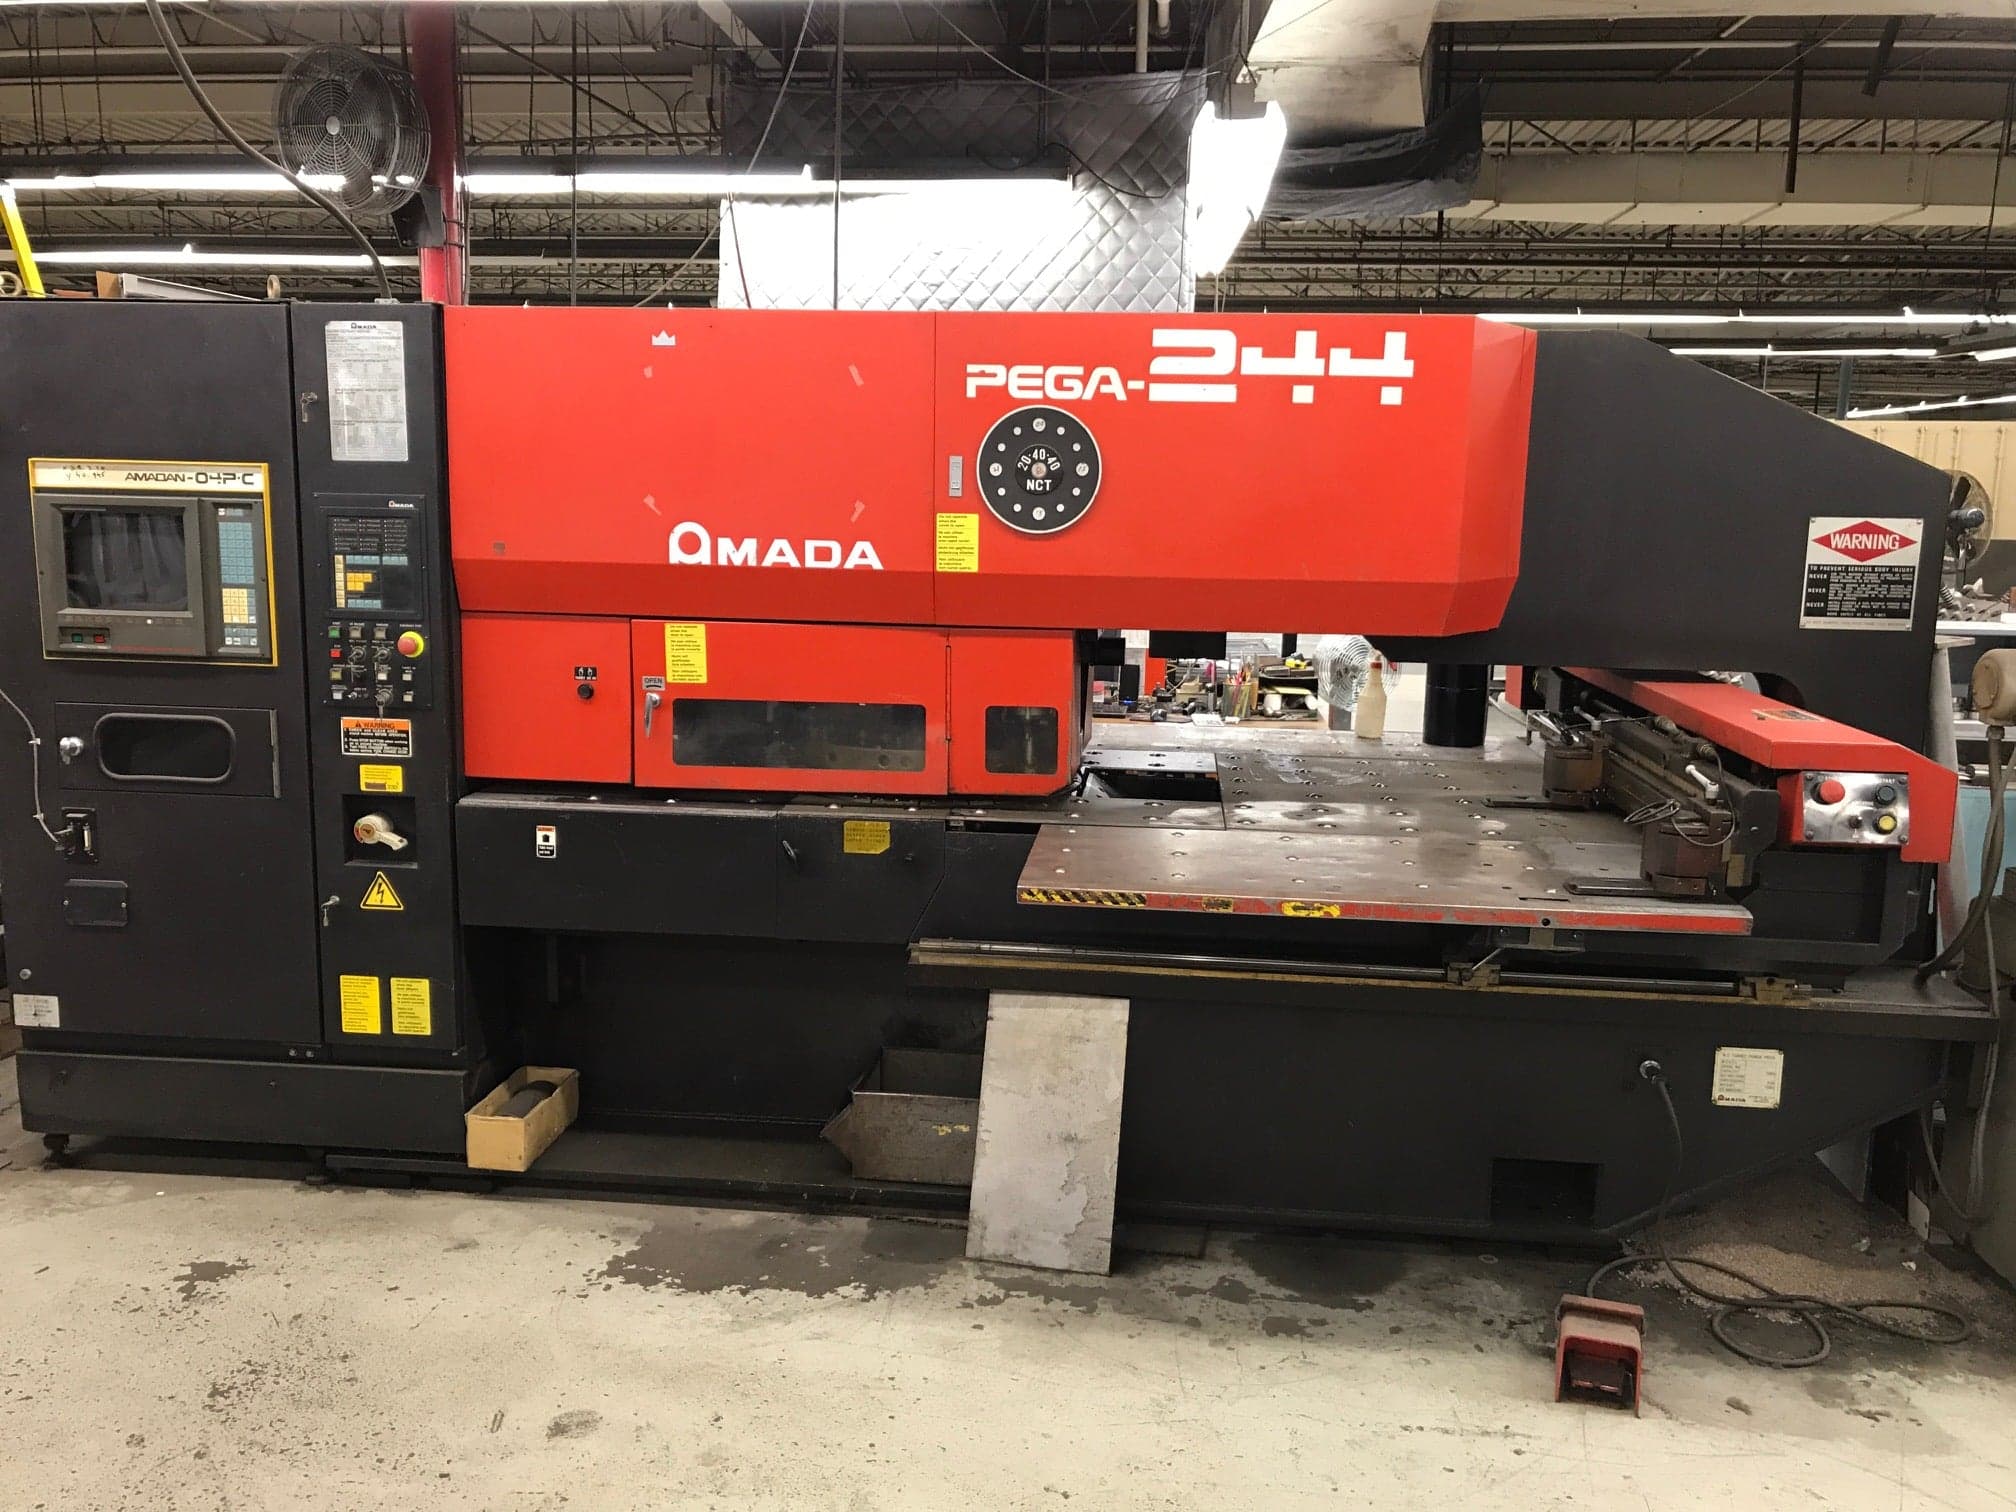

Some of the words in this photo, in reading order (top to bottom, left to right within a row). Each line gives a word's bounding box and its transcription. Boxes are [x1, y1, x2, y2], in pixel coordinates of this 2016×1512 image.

[1026, 479, 1052, 491] NCT
[668, 521, 884, 570] AMADA
[1830, 533, 1900, 550] WARNING
[363, 721, 396, 729] WARNING
